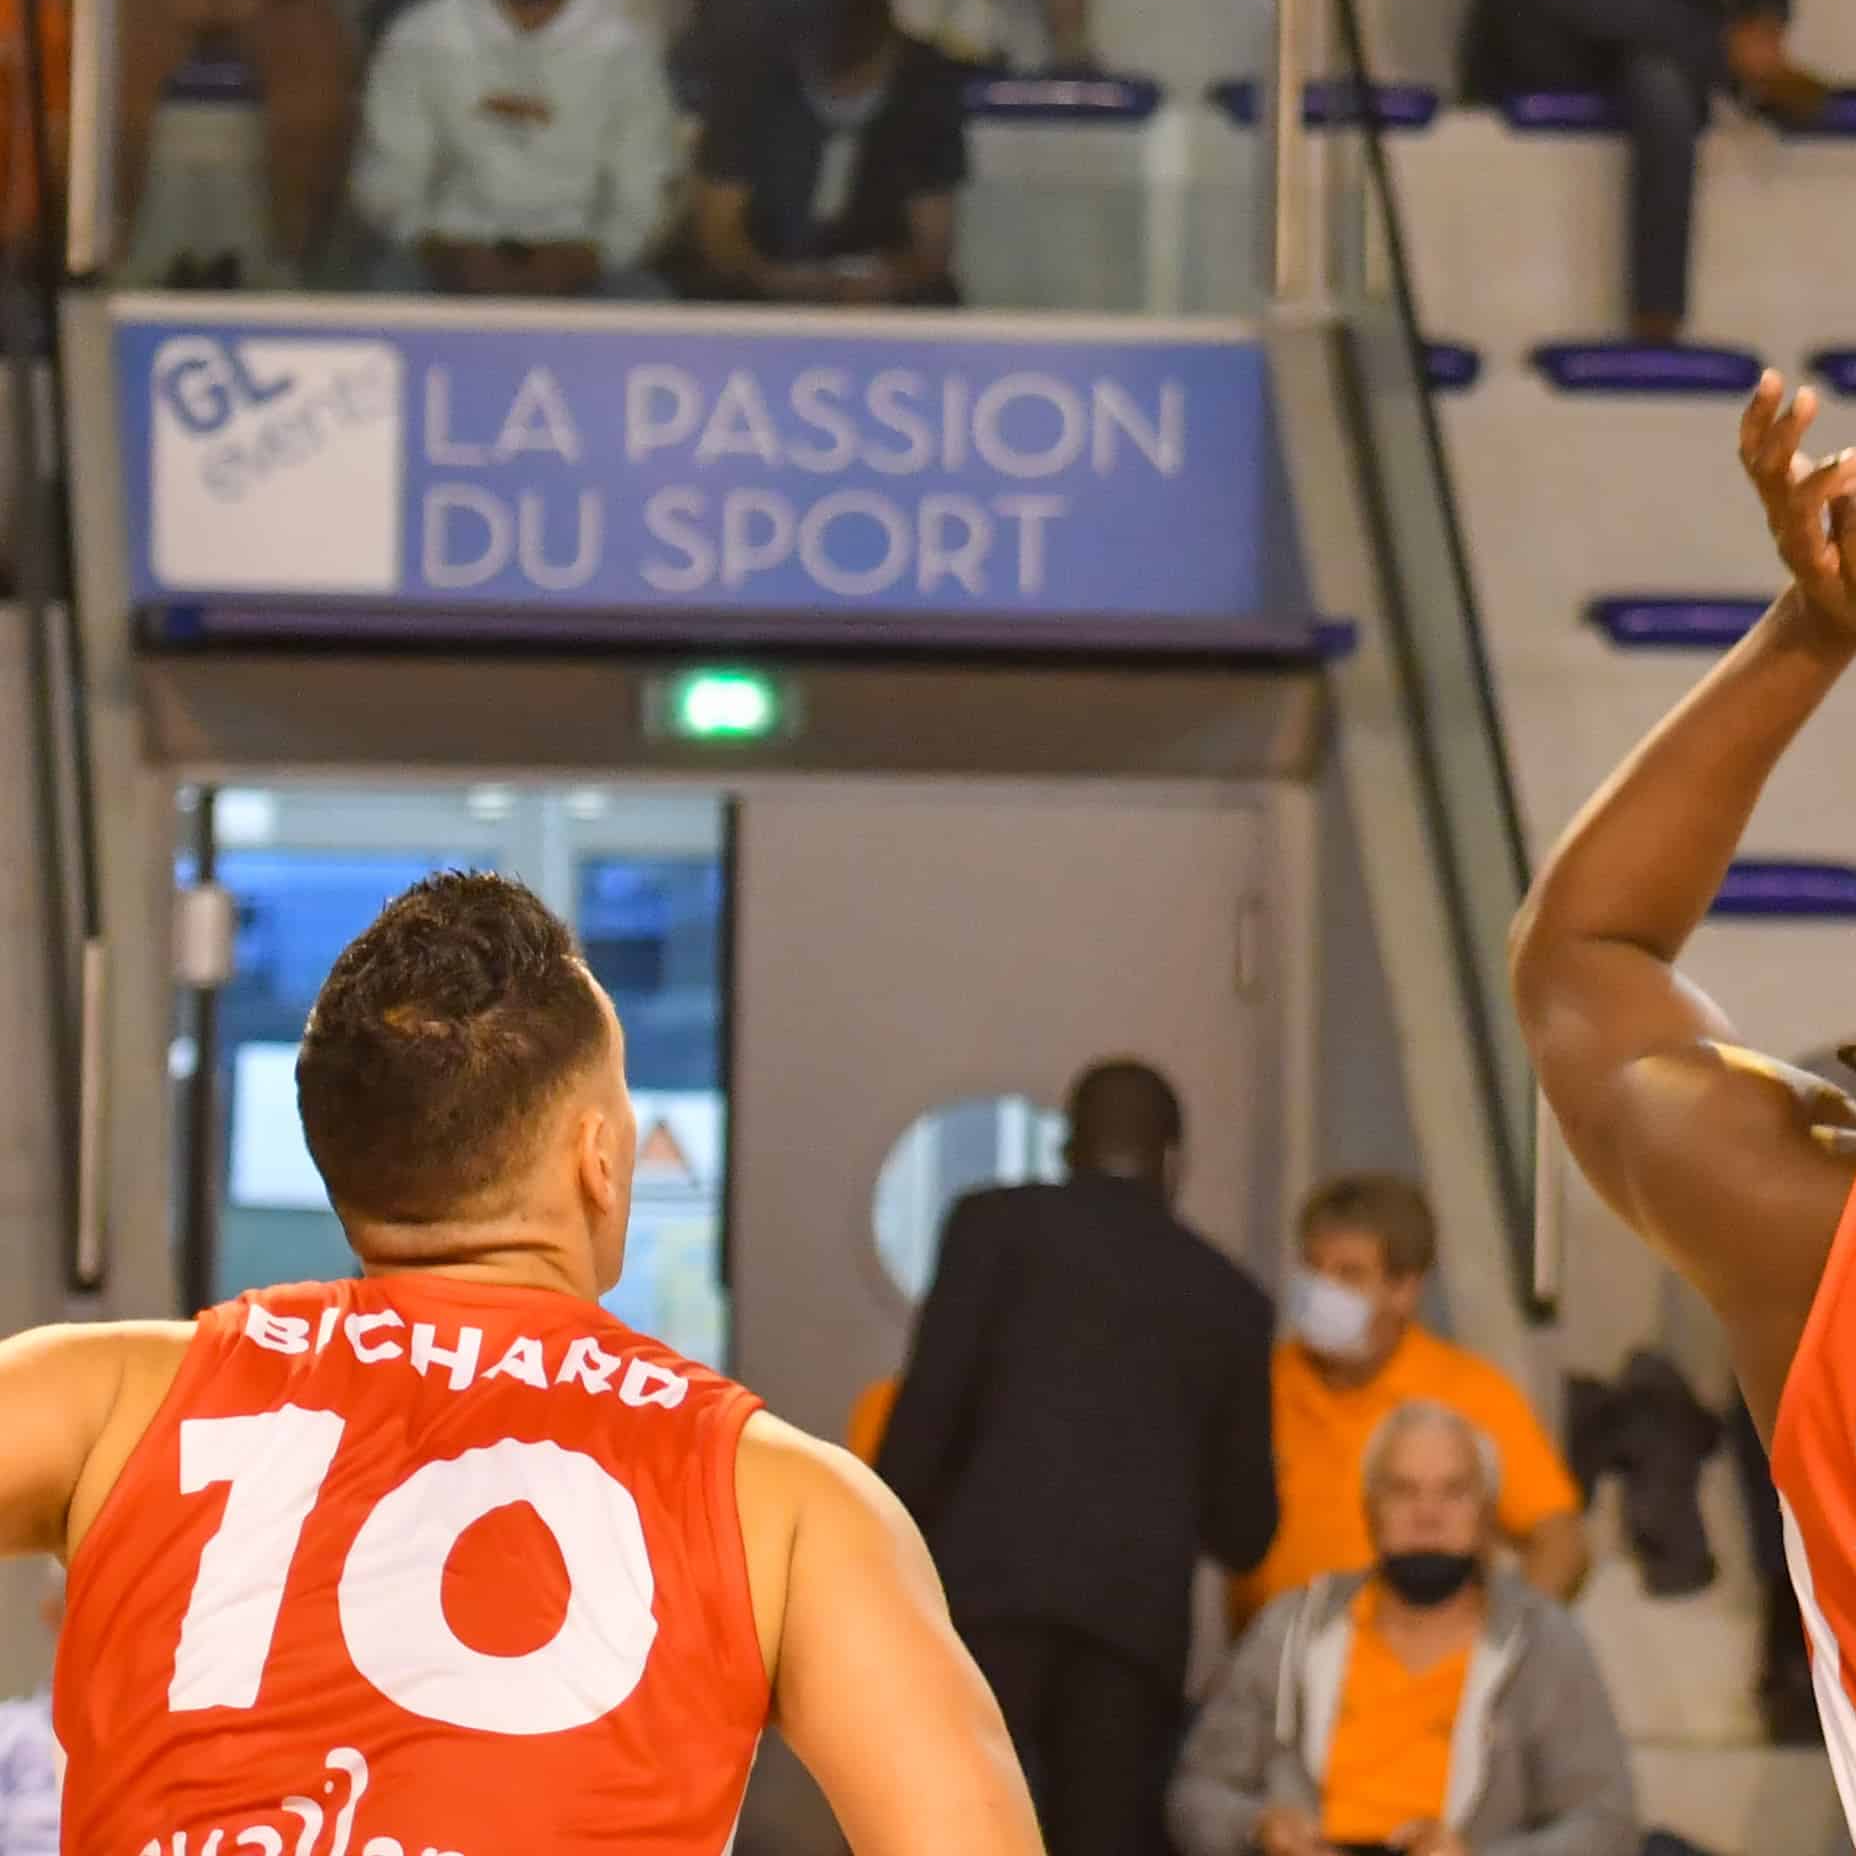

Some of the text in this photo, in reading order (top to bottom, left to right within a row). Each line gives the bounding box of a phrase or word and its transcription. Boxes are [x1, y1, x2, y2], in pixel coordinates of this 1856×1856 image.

[166, 336, 294, 435] GL
[425, 364, 1186, 478] LA PASSION
[422, 482, 1069, 596] DU SPORT
[245, 1302, 689, 1409] BICHARD
[168, 1402, 658, 1735] 10
